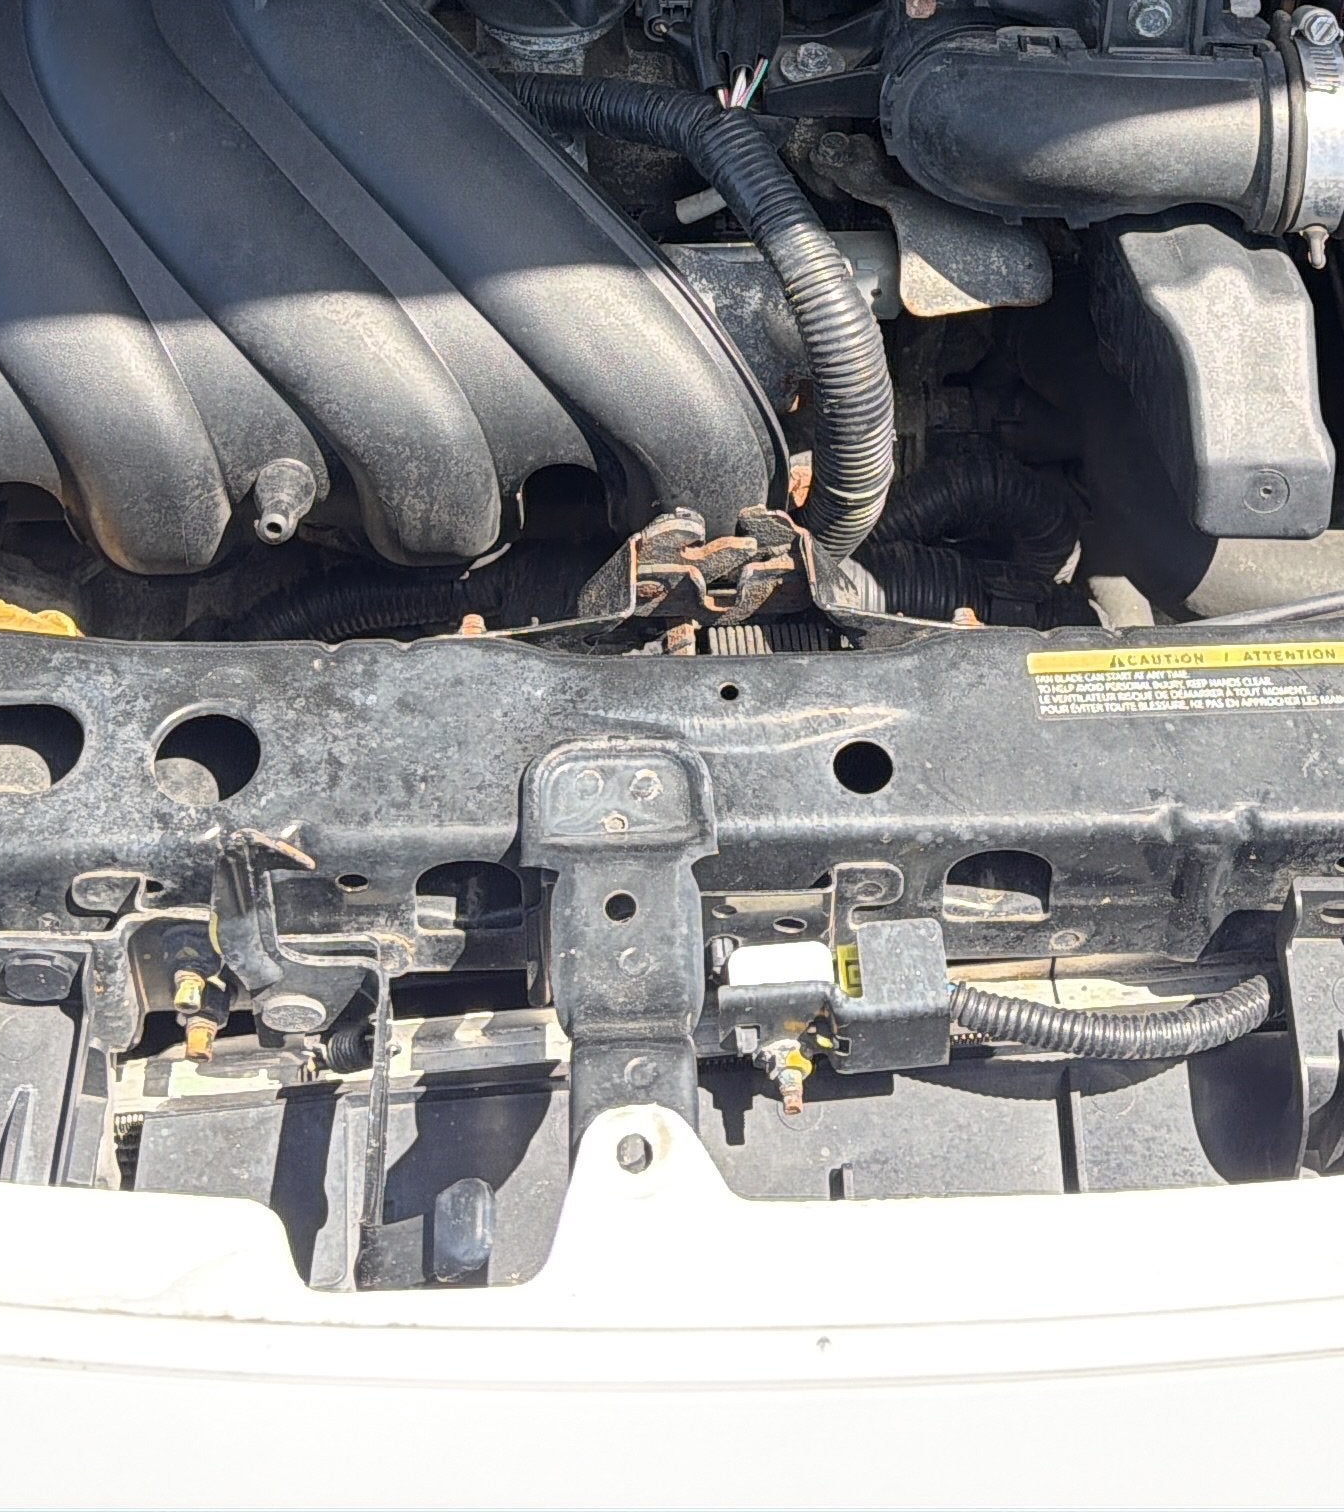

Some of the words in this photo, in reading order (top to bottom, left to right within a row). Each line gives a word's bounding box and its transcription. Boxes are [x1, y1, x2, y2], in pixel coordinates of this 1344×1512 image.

[1127, 652, 1204, 666] CAUTION
[1243, 648, 1337, 662] ATTENTION
[1052, 684, 1075, 694] HELP
[1235, 686, 1260, 697] TOUT
[1040, 705, 1069, 715] POUR
[1207, 698, 1224, 709] PAS
